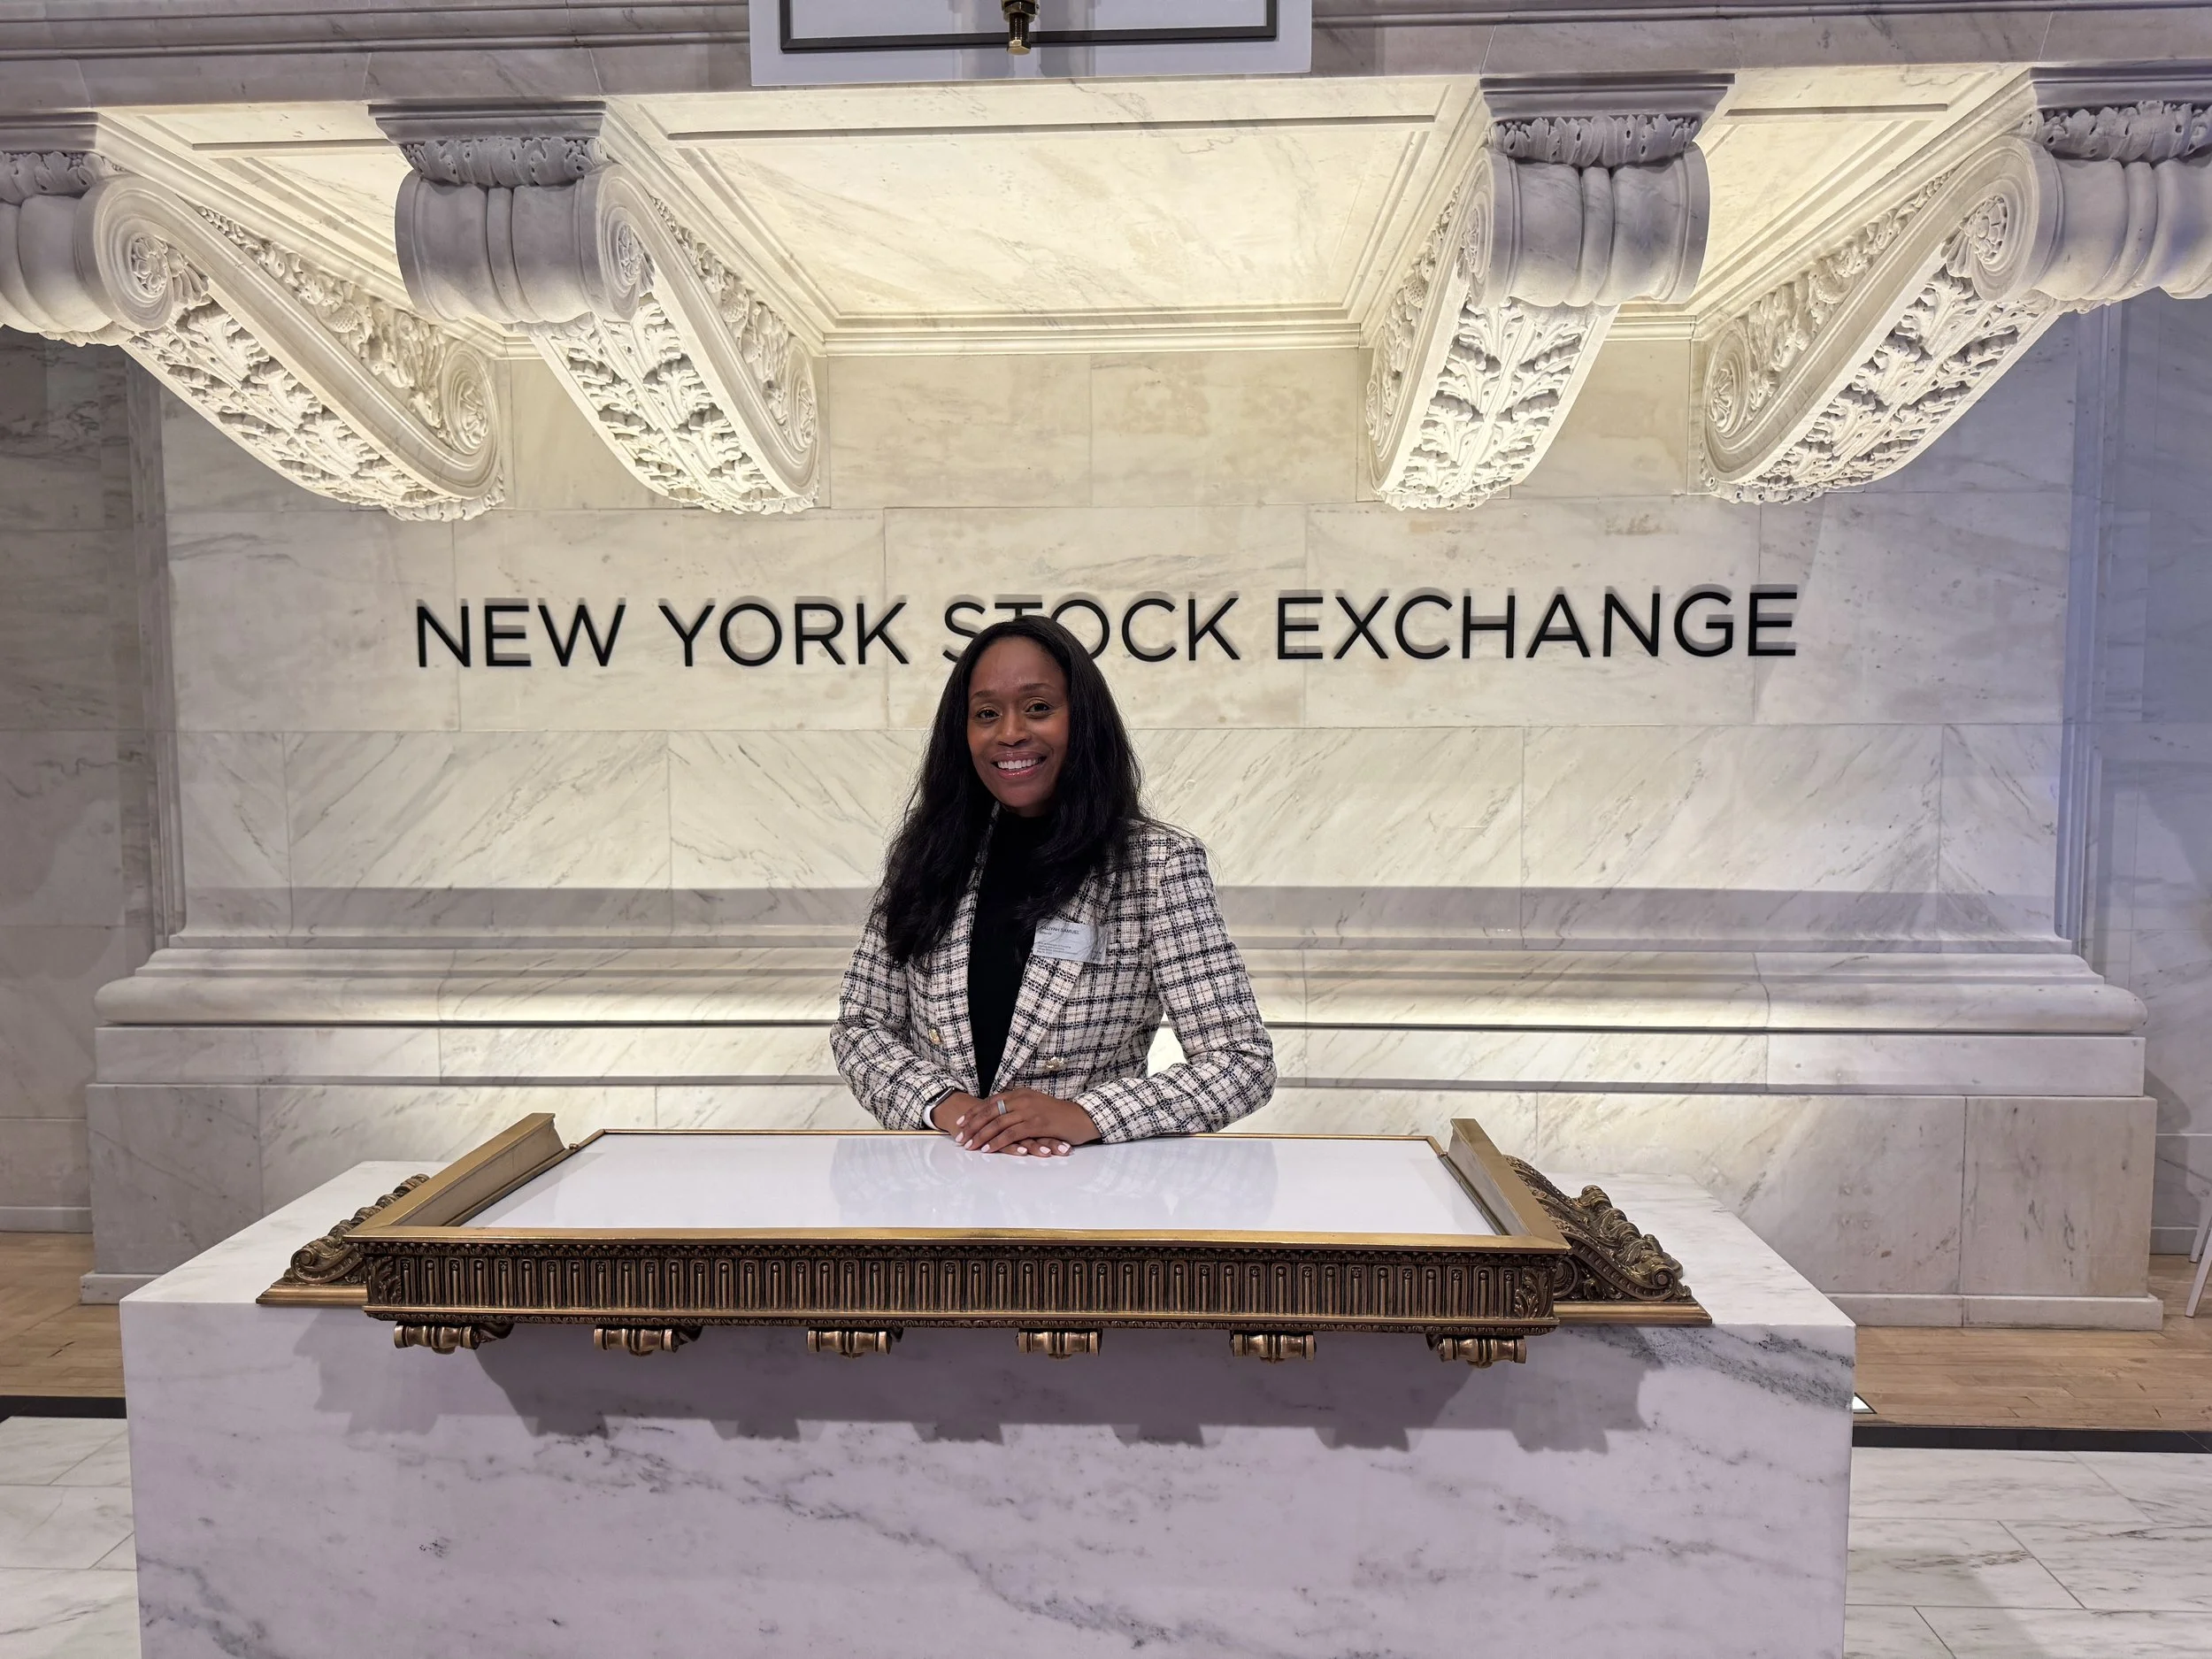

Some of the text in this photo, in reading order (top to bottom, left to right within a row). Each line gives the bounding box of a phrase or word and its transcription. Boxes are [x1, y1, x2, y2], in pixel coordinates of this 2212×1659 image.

[416, 603, 626, 668] NEW
[658, 602, 910, 667] YORK
[1277, 590, 1798, 660] EXCHANGE
